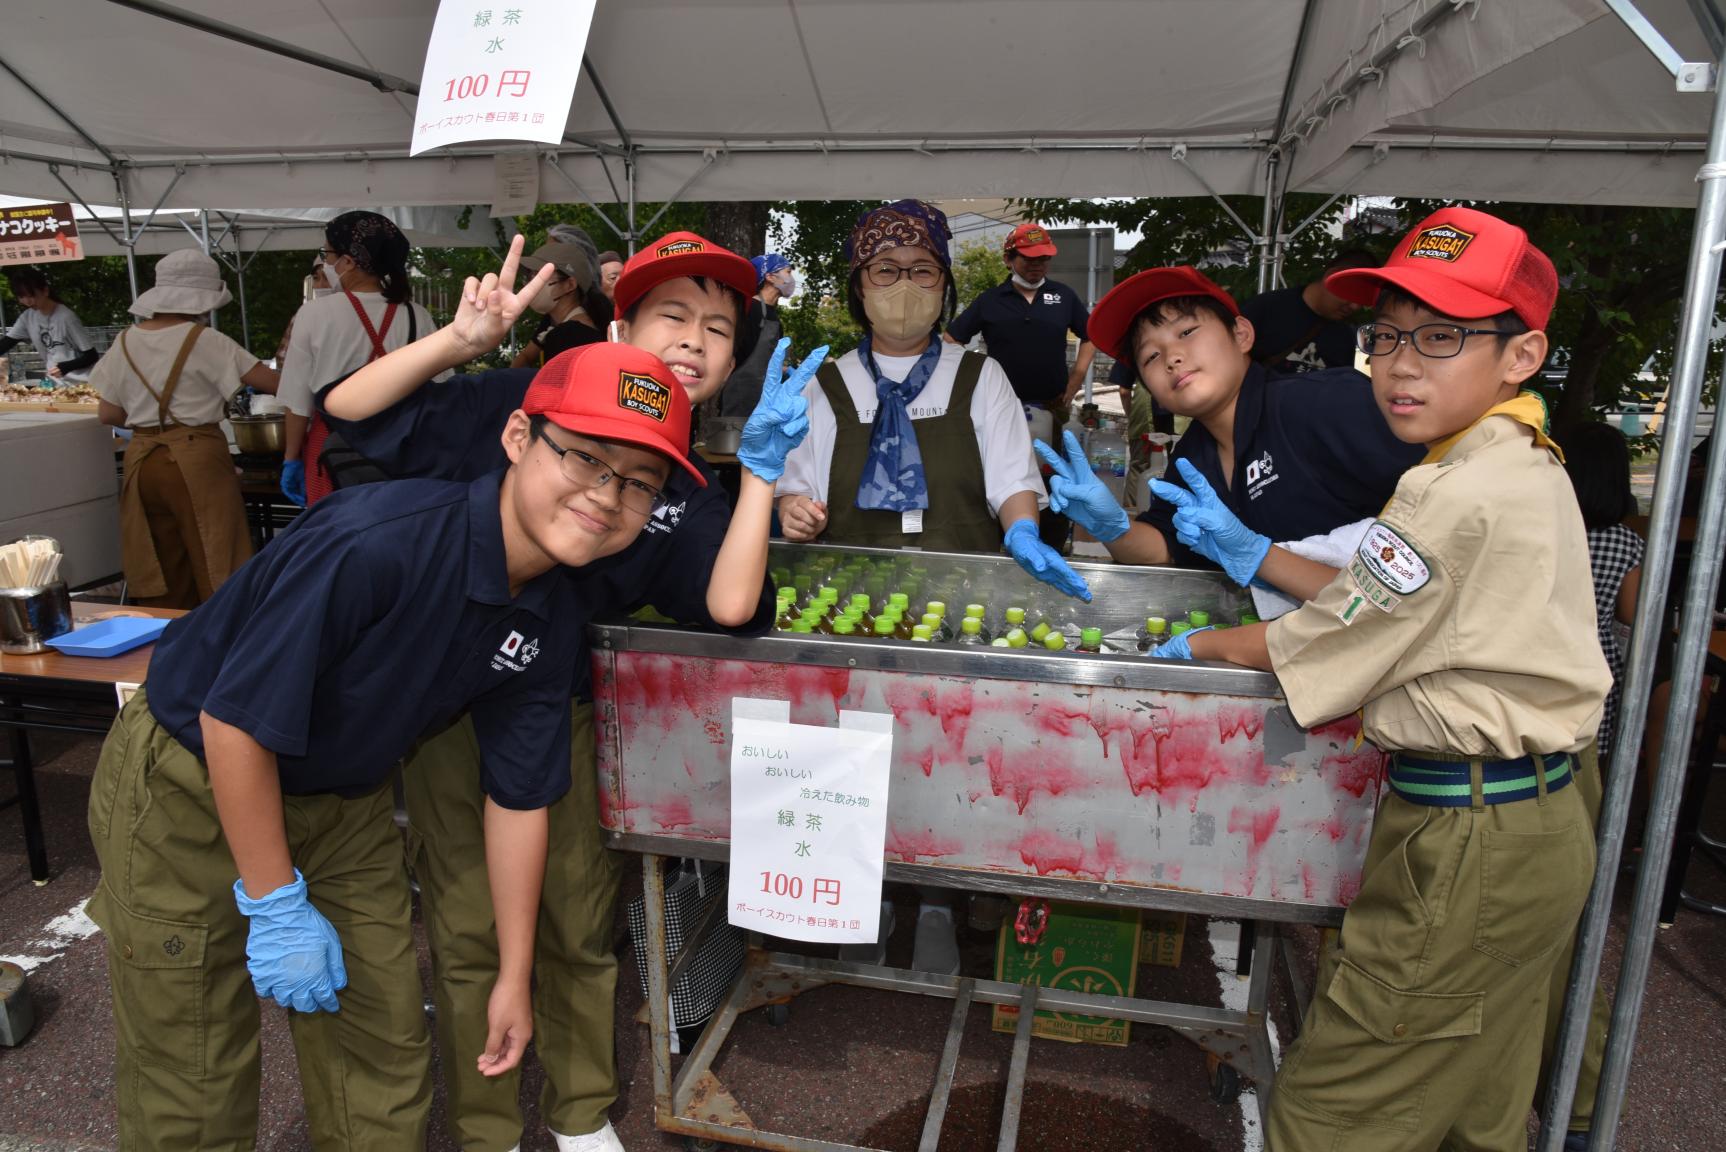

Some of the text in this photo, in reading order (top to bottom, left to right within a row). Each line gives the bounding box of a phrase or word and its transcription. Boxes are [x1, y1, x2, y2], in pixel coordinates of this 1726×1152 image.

[484, 36, 505, 54] 水
[1428, 230, 1457, 238] FUKUOKA
[633, 378, 660, 392] FUKUOKA
[639, 403, 659, 416] SCOUTS
[1390, 562, 1415, 580] 2025
[1351, 563, 1391, 608] KASUGA
[1343, 596, 1364, 620] 1
[741, 746, 789, 760] おいしい
[765, 766, 812, 780] おいしい
[799, 788, 870, 808] 冷えた飲み物
[794, 841, 811, 857] 水
[760, 871, 841, 906] 100 円
